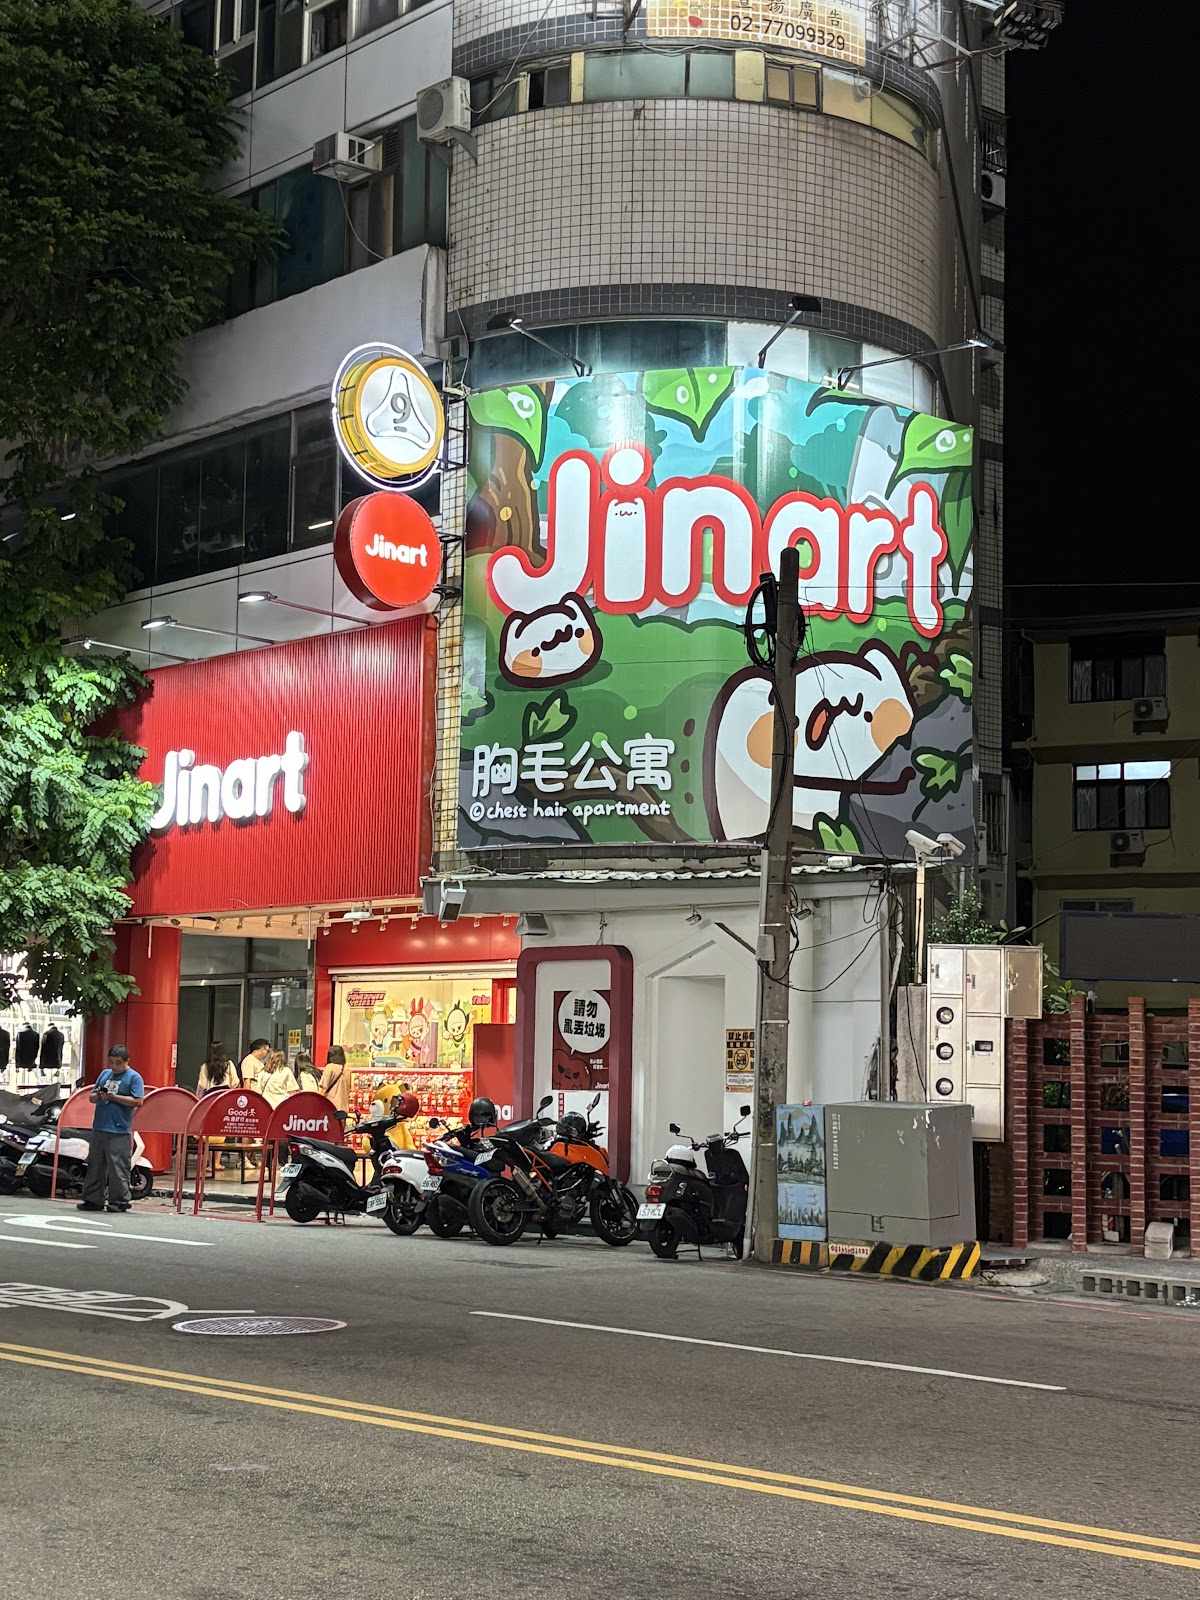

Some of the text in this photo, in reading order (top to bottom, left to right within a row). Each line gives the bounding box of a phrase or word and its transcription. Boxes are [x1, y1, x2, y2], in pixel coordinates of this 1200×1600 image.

[730, 15, 846, 50] 02-77099329
[365, 533, 428, 567] Jinart
[487, 440, 948, 638] Jinart
[150, 730, 309, 829] Jinart
[471, 732, 675, 798] 胸毛公寓
[533, 798, 568, 818] hair
[572, 800, 671, 826] apartment
[573, 998, 598, 1019] 請勿
[563, 1018, 606, 1038] 亂丟垃圾
[228, 1107, 249, 1117] Good
[282, 1114, 330, 1133] Jinart
